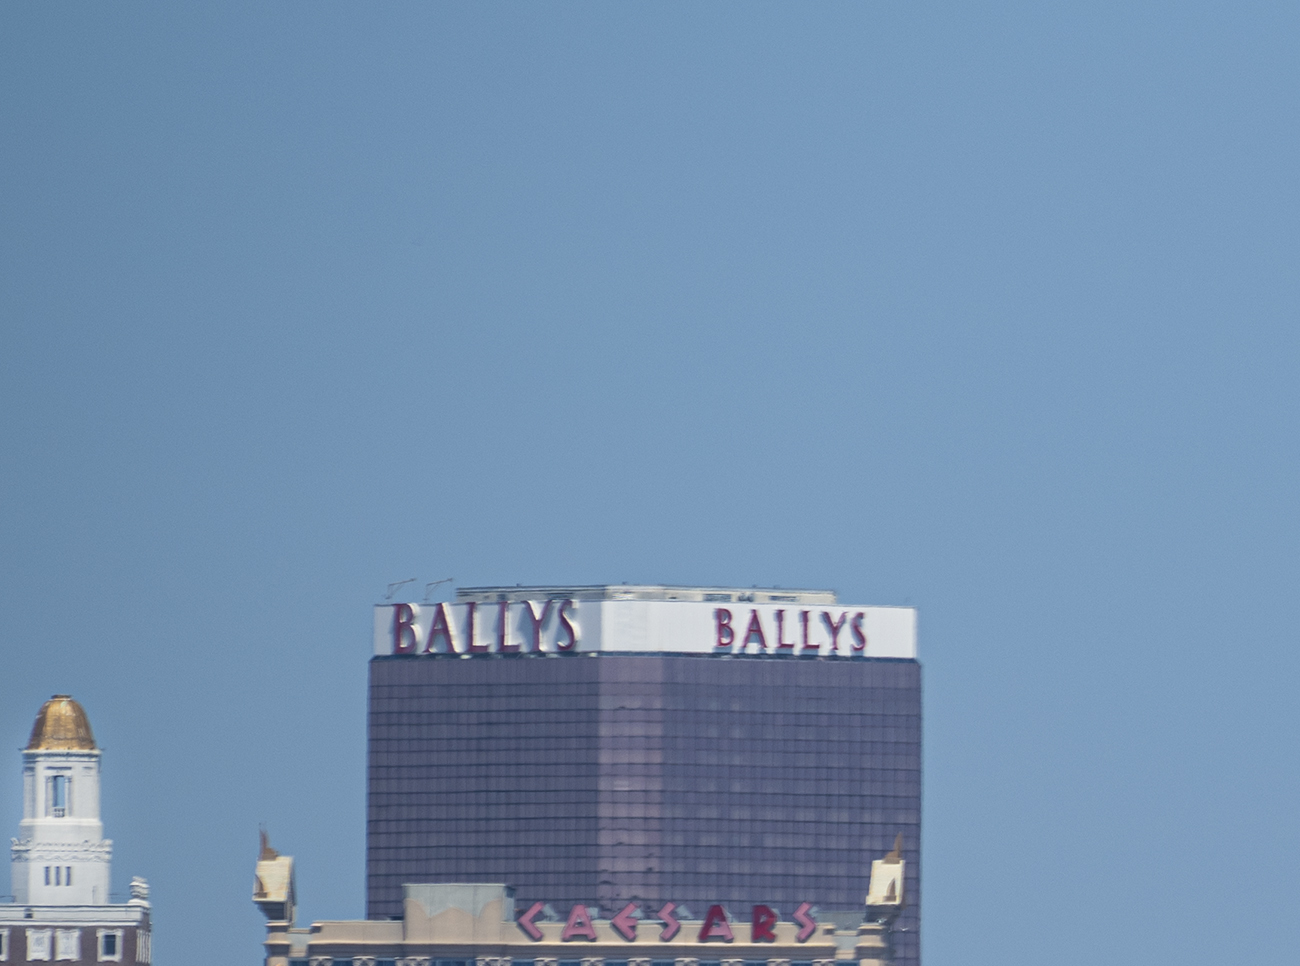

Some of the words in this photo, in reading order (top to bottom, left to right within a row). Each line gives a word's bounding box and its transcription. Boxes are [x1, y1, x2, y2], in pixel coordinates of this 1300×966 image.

[392, 600, 582, 655] BALLYS
[714, 607, 868, 652] BALLYS
[517, 901, 818, 943] CAESARS
